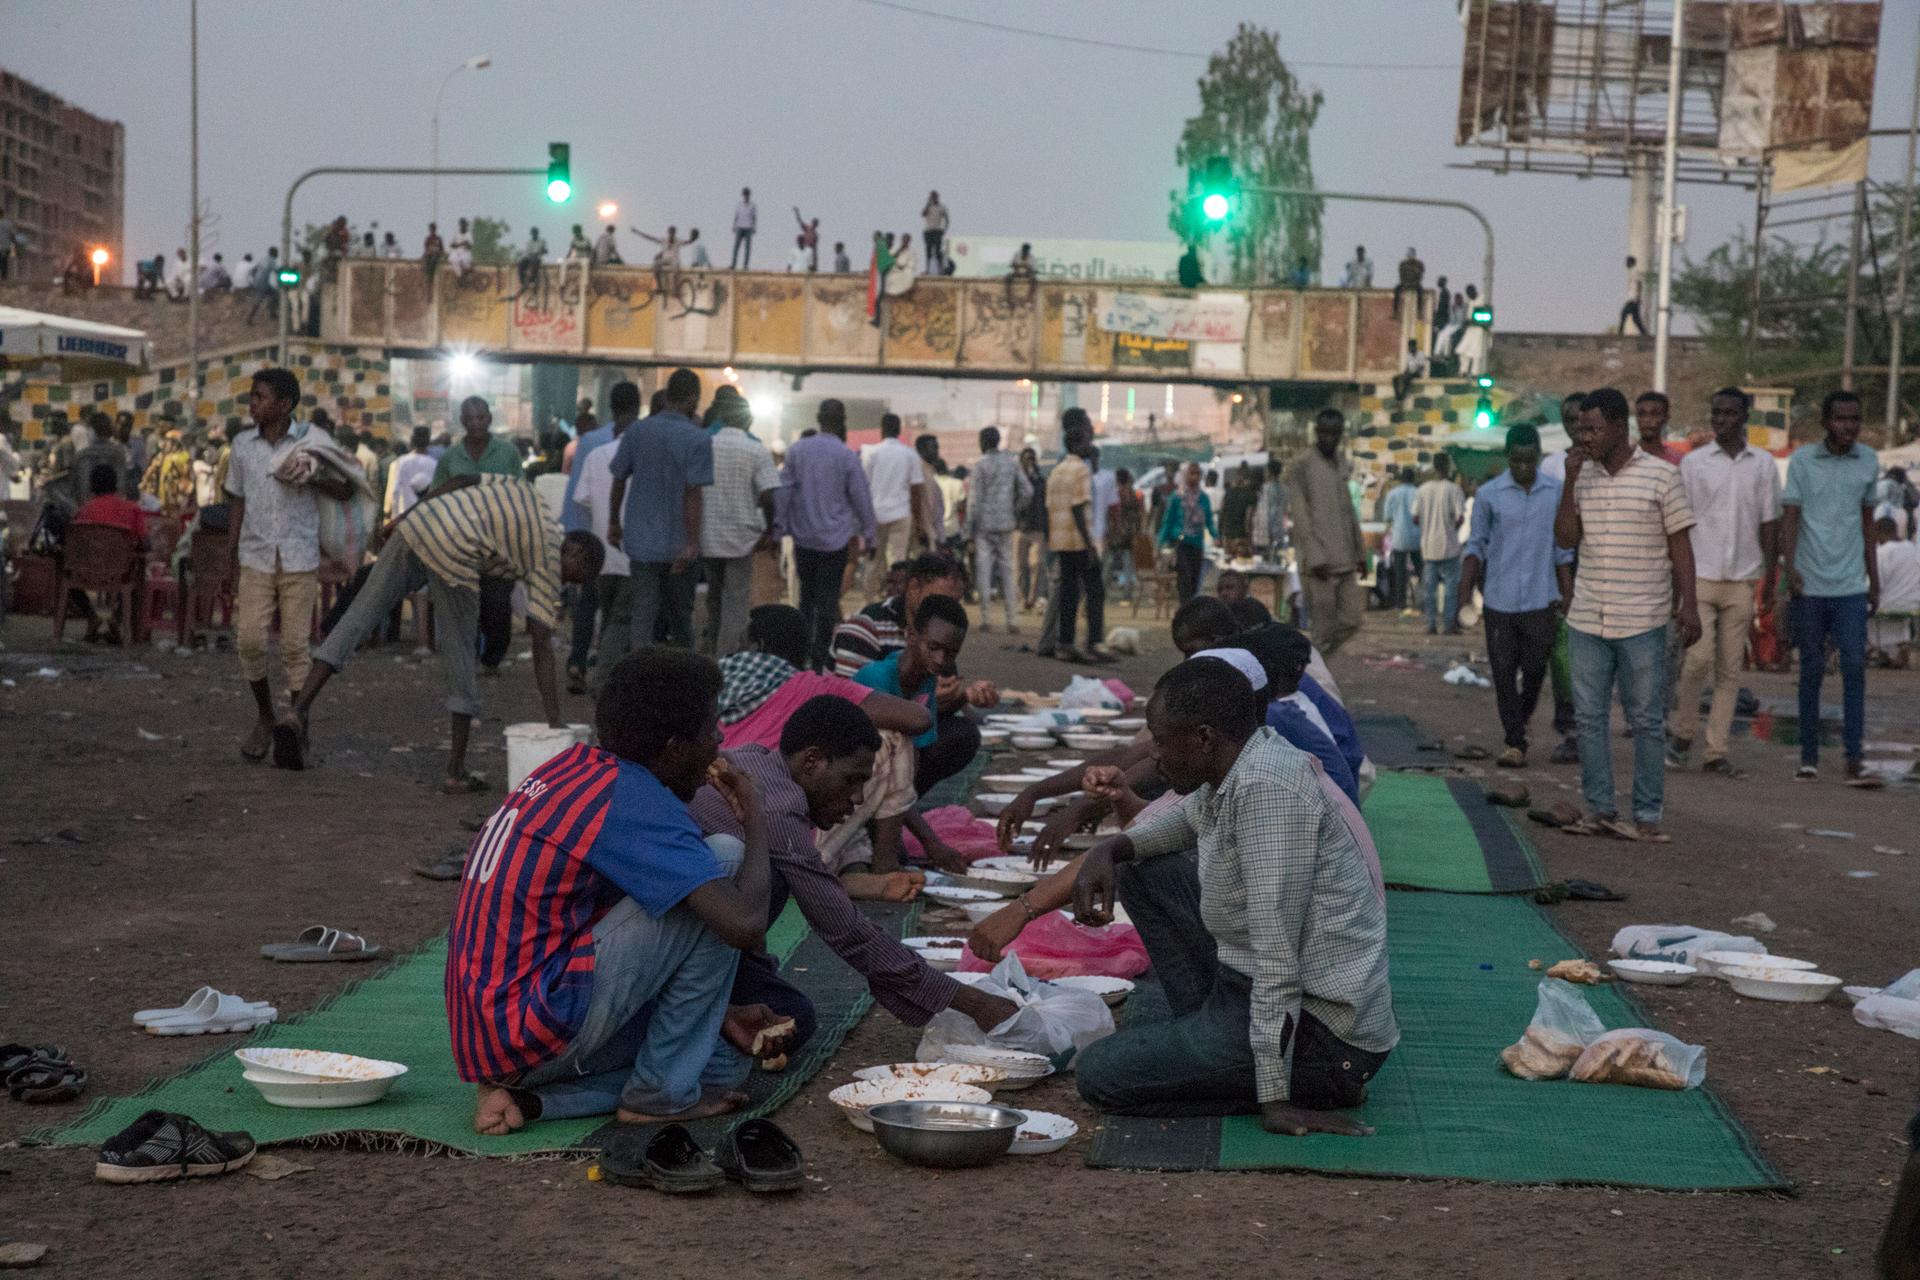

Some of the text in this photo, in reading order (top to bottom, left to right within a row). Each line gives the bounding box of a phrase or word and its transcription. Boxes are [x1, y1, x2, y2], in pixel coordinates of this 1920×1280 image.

[57, 334, 127, 359] LIEBHERR
[517, 777, 549, 801] ESSI
[467, 805, 519, 884] 10
